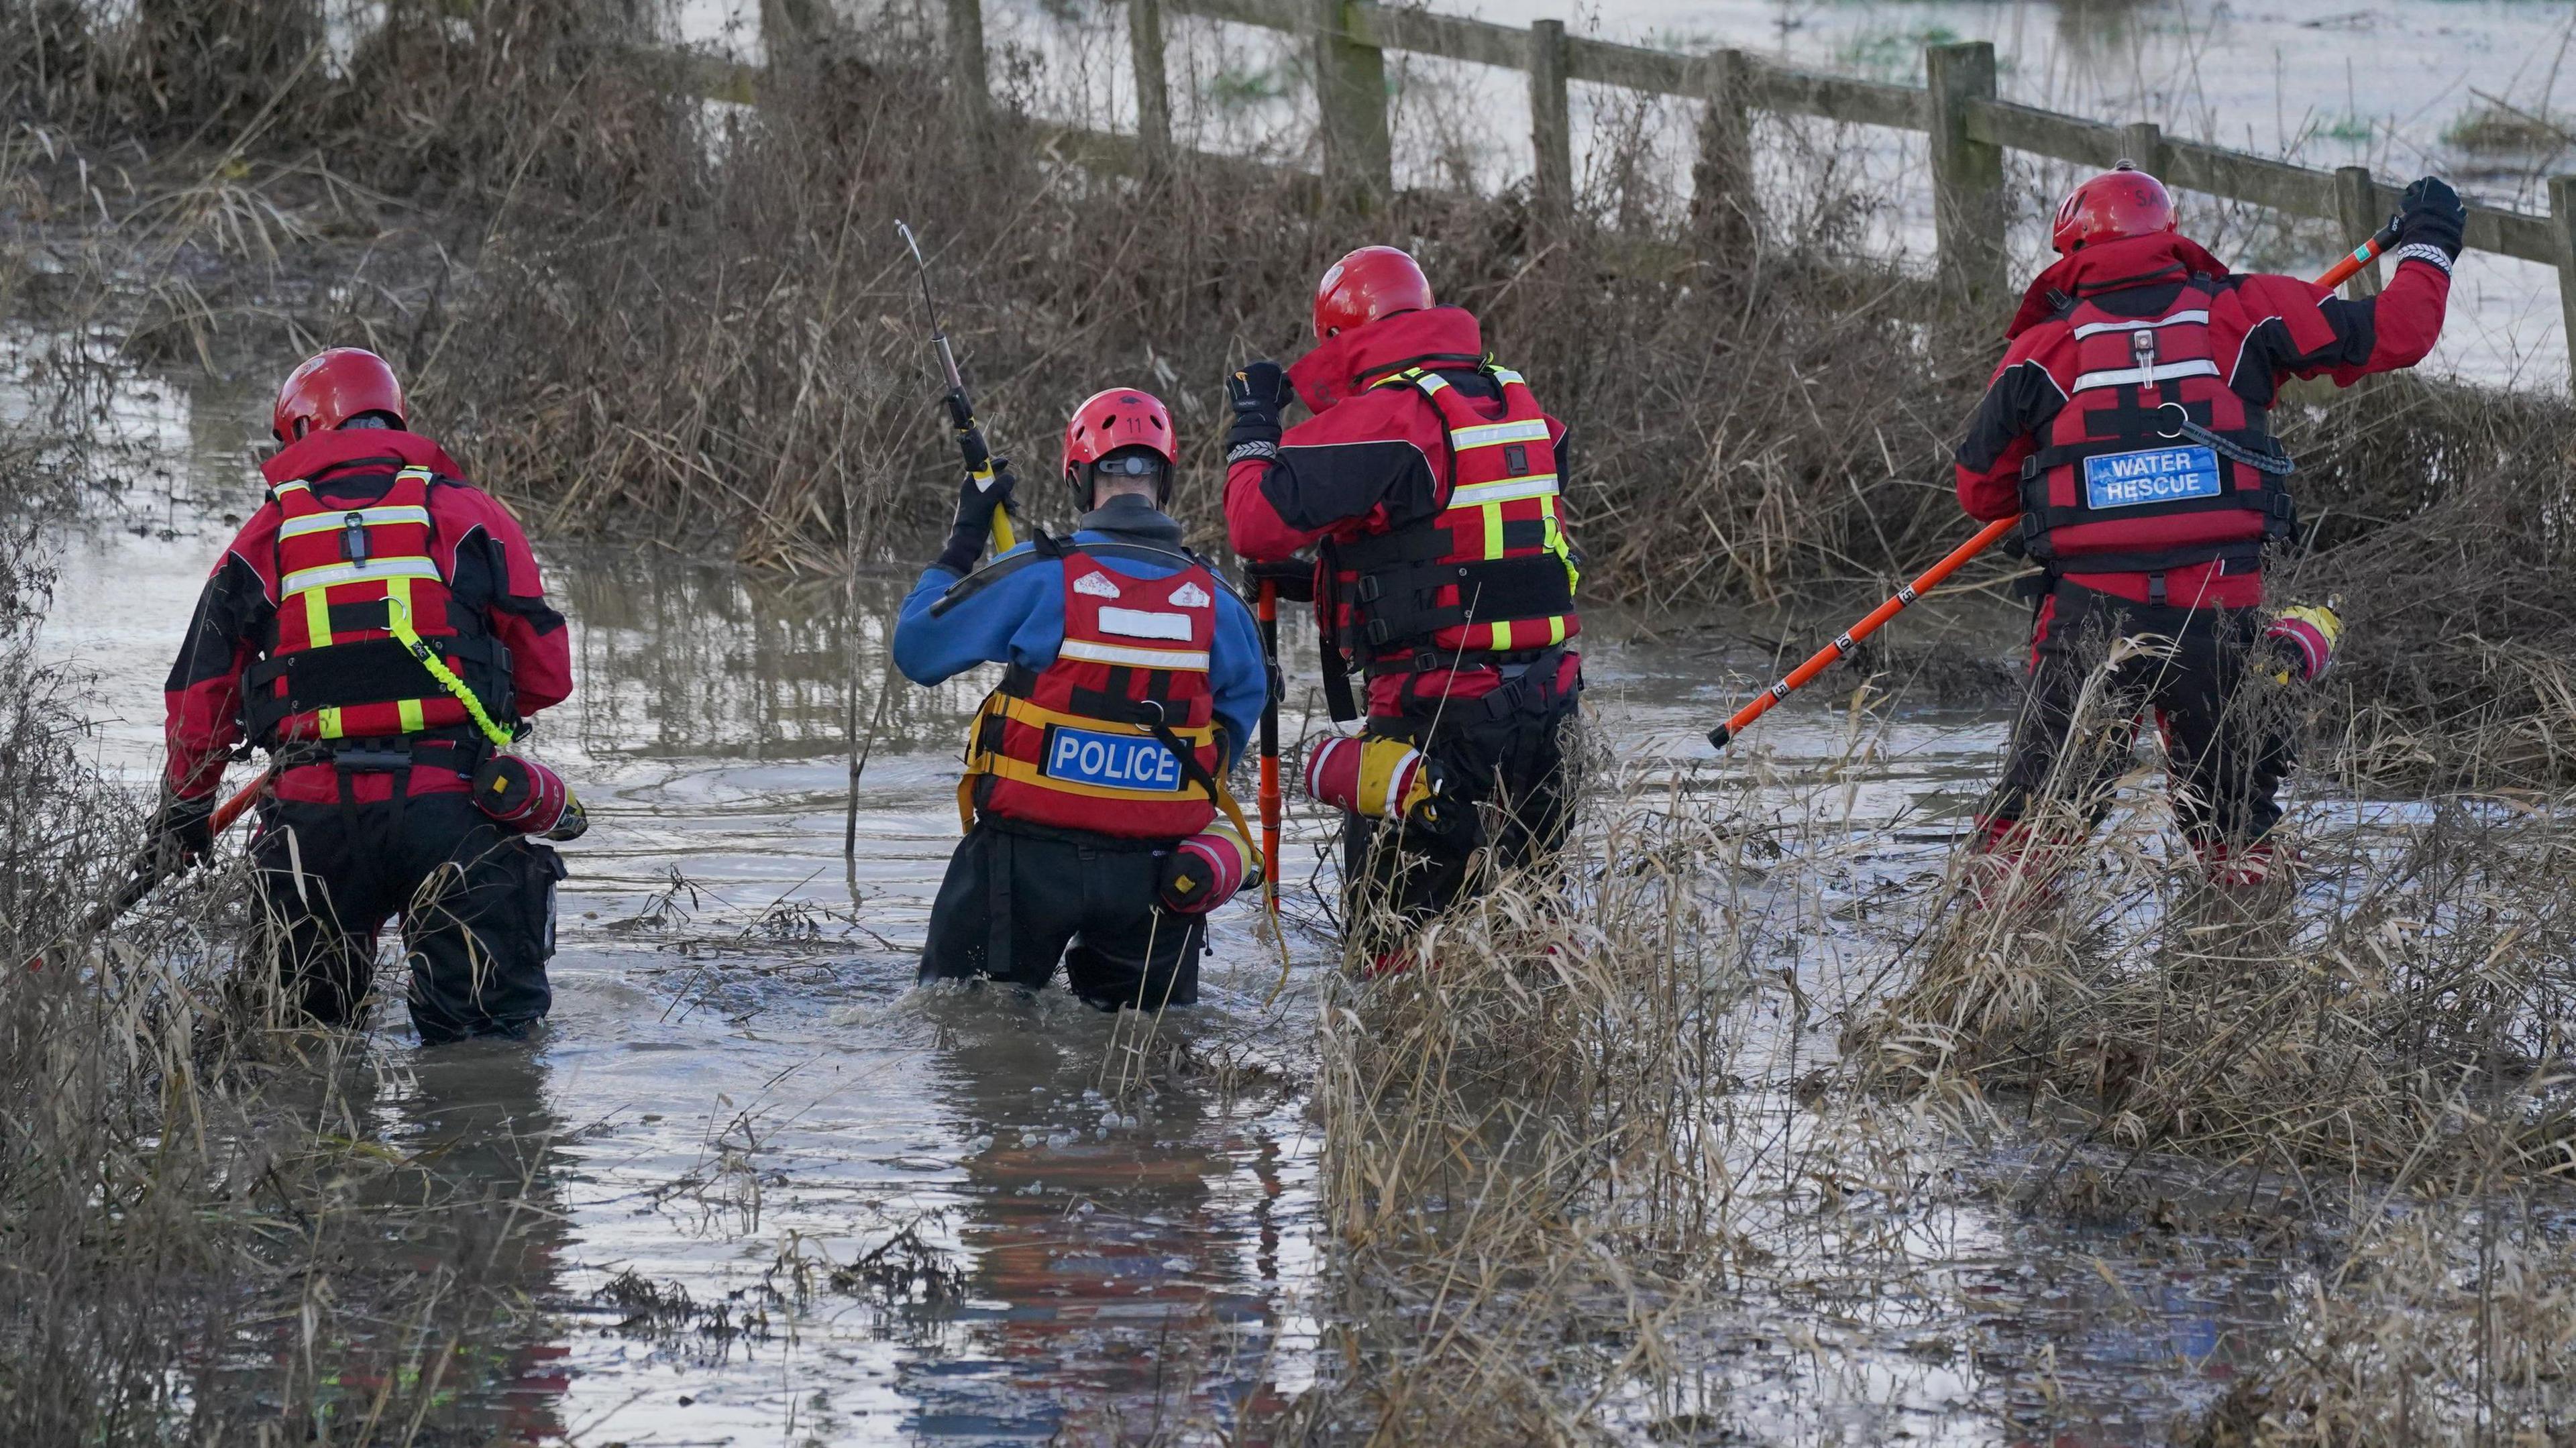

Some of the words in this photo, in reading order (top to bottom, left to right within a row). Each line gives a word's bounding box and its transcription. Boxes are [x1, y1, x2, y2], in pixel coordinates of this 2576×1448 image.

[1127, 418, 1140, 433] 11
[2112, 453, 2191, 478] WATER
[2107, 473, 2200, 500] RESCUE
[1056, 736, 1174, 781] POLICE
